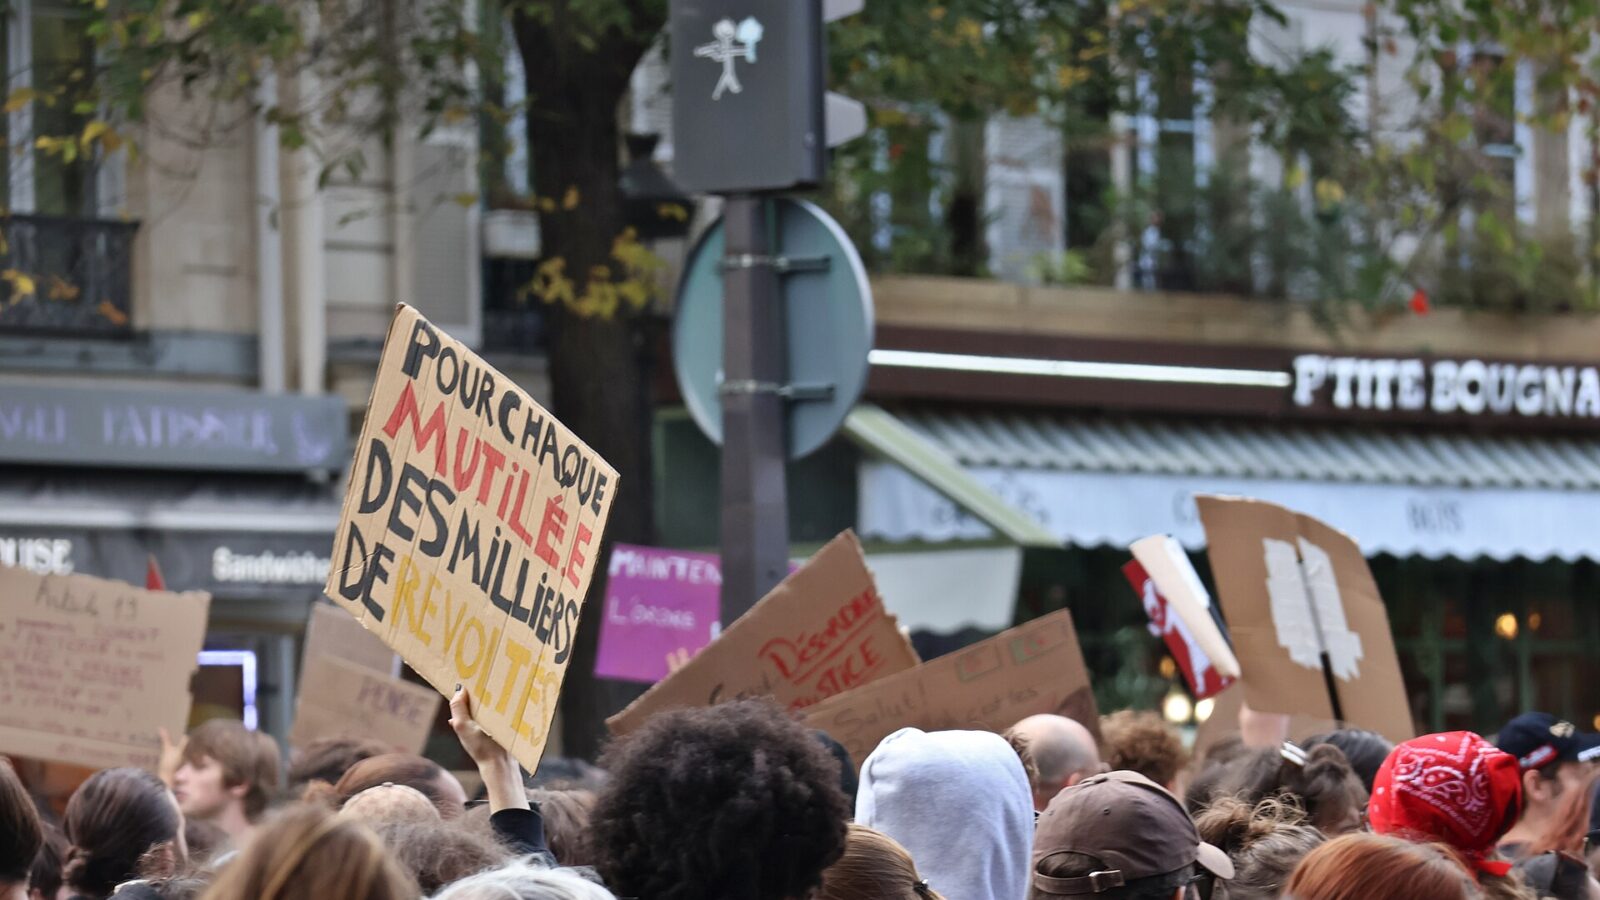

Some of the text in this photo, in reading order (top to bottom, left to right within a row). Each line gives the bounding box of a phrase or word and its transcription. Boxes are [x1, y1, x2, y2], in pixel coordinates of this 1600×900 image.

[402, 319, 608, 517] POUR CHAQUE
[1292, 354, 1600, 417] P'TITE BOUGNA
[358, 438, 457, 558] DES
[0, 537, 75, 575] UISE
[339, 521, 395, 622] DE
